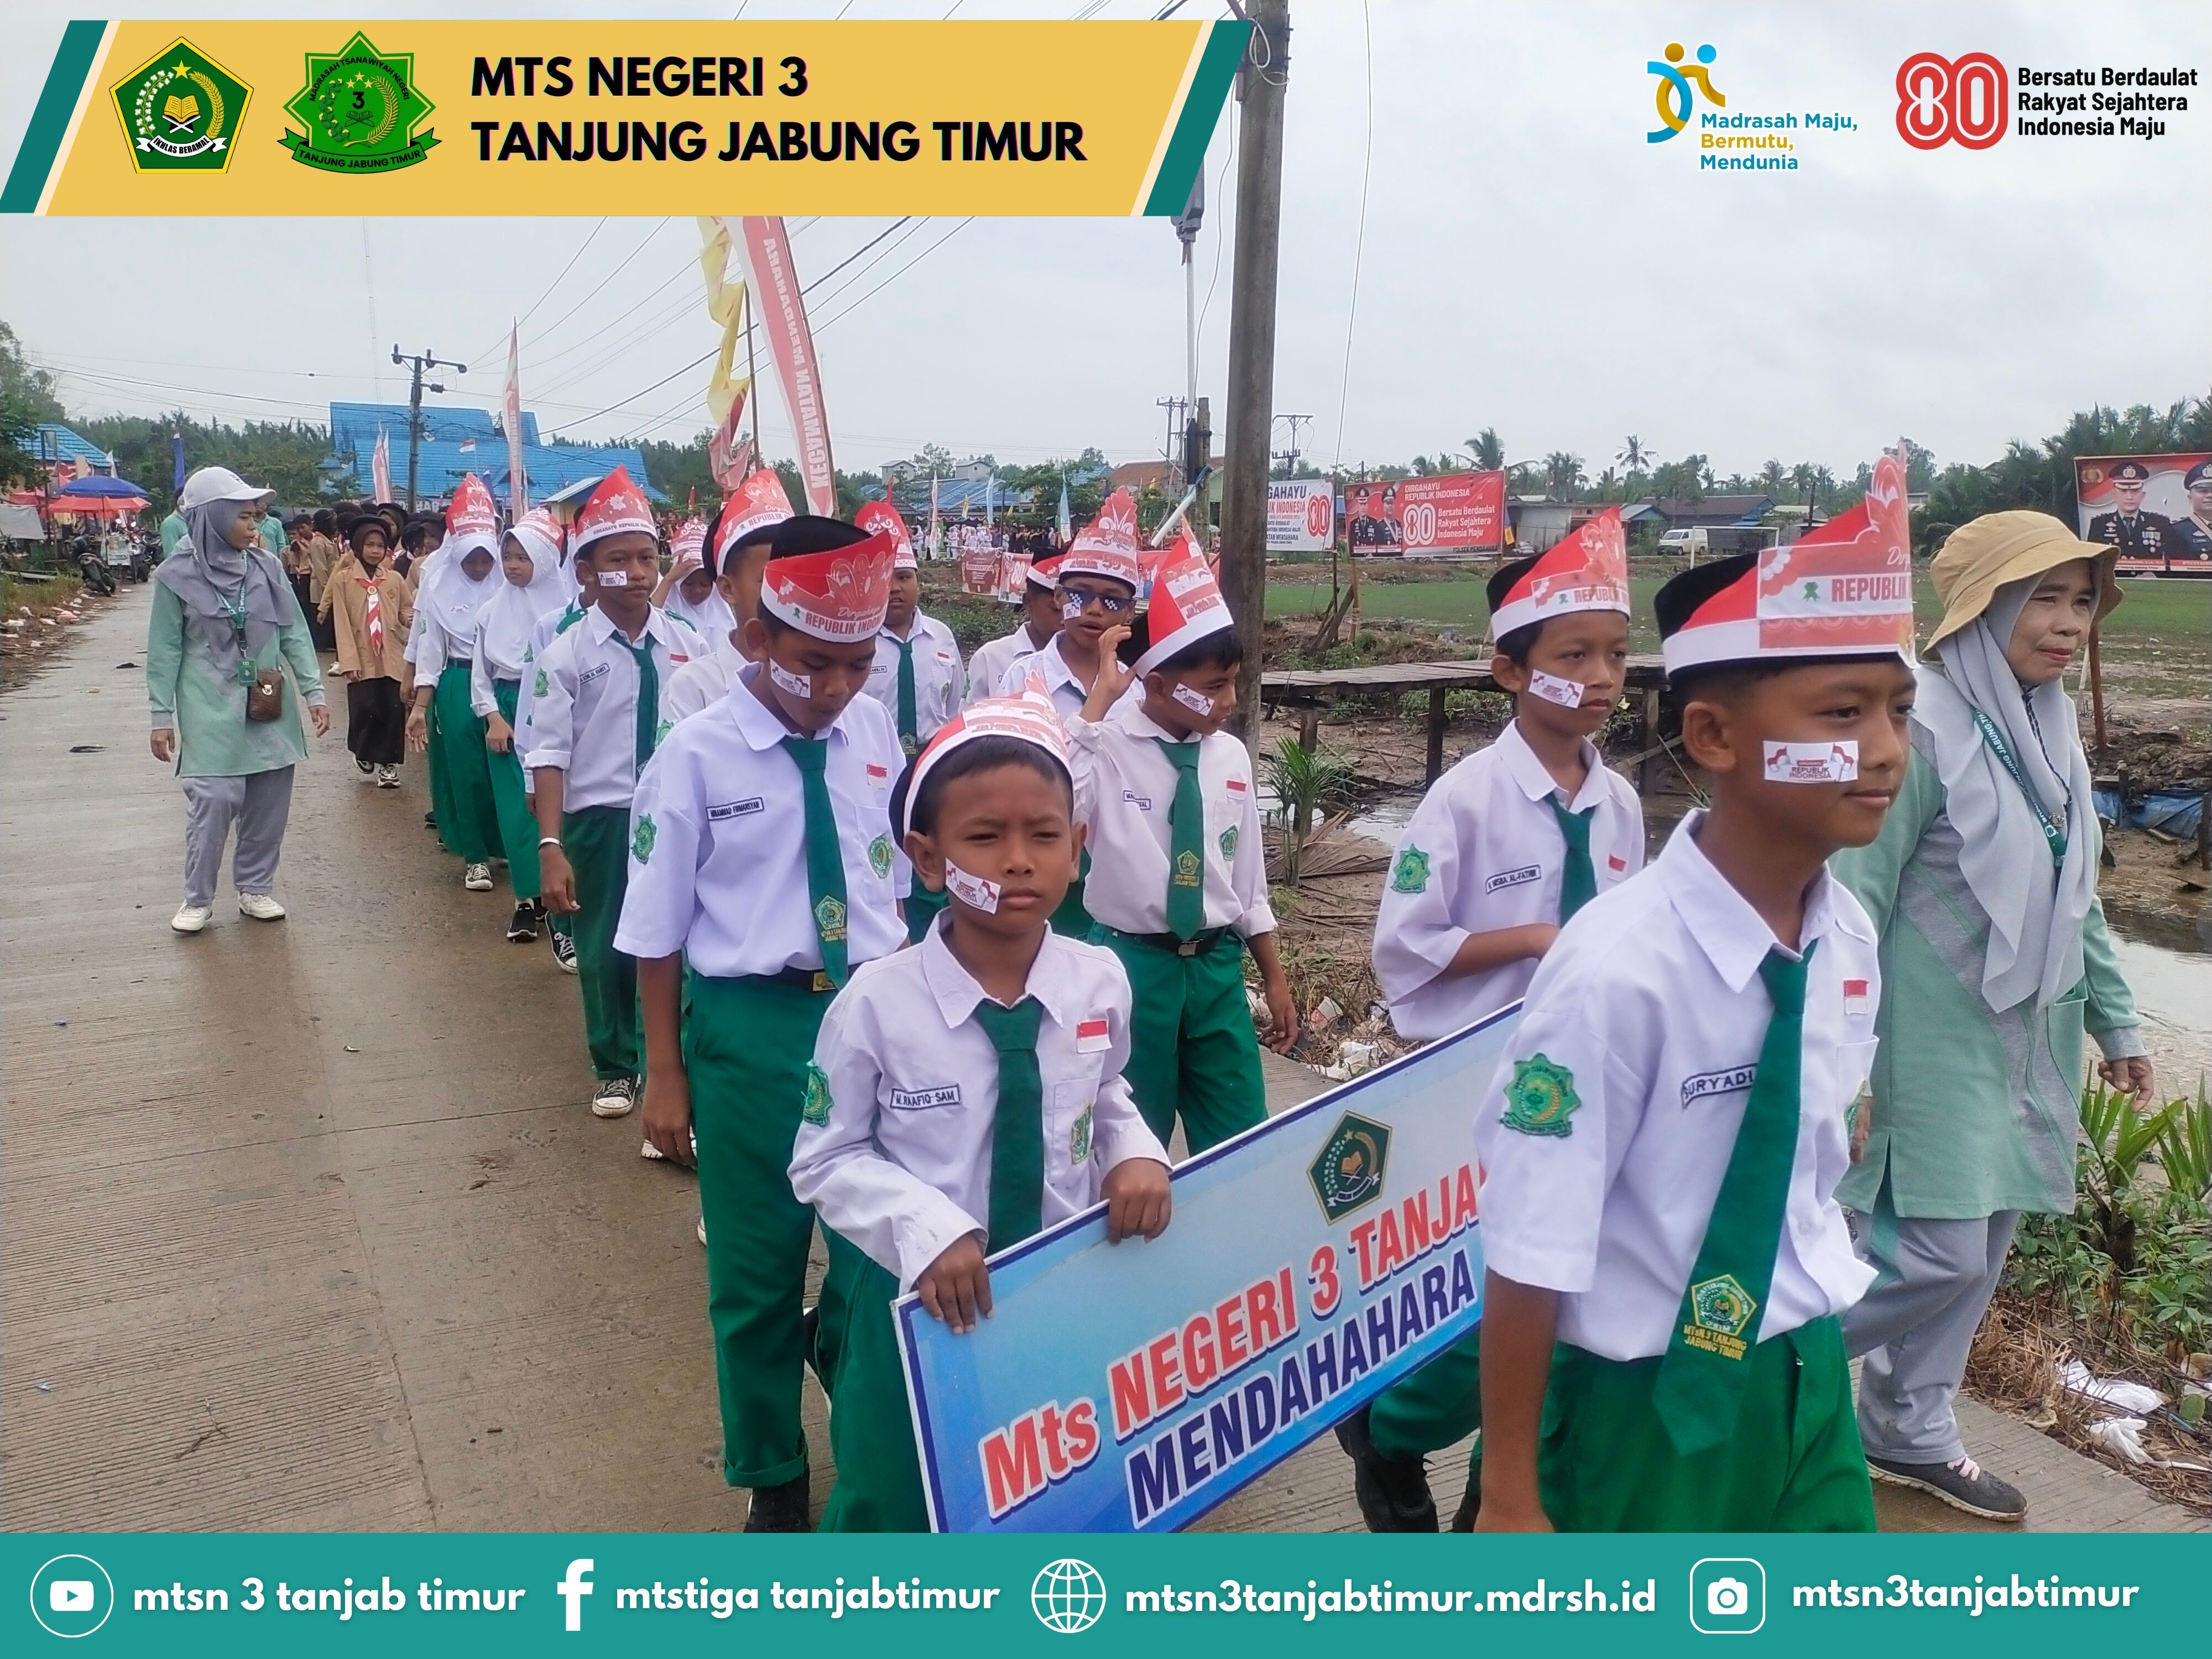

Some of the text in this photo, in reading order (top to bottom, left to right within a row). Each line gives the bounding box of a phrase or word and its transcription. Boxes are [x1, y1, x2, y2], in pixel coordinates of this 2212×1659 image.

[1405, 483, 1440, 493] DIRGAHAYU
[1405, 489, 1469, 501] REPUBLIK INDONESIA
[1276, 501, 1305, 513] INDONESIA
[1307, 495, 1330, 537] 80
[1438, 505, 1495, 517] Bersatu Berdaulat
[1403, 503, 1436, 545] 80
[1438, 517, 1491, 529] Rakyat Sejahtera
[1438, 528, 1483, 538] Indonesia Maju
[805, 612, 856, 635] REPUBLIK
[1984, 723, 2006, 754] JABUNG
[1683, 1070, 1753, 1099] SURYADI
[935, 1090, 956, 1103] SAM
[983, 1159, 1486, 1510] Mts NEGERI 3 TANJA
[1128, 1249, 1475, 1522] MENDAHAHARA
